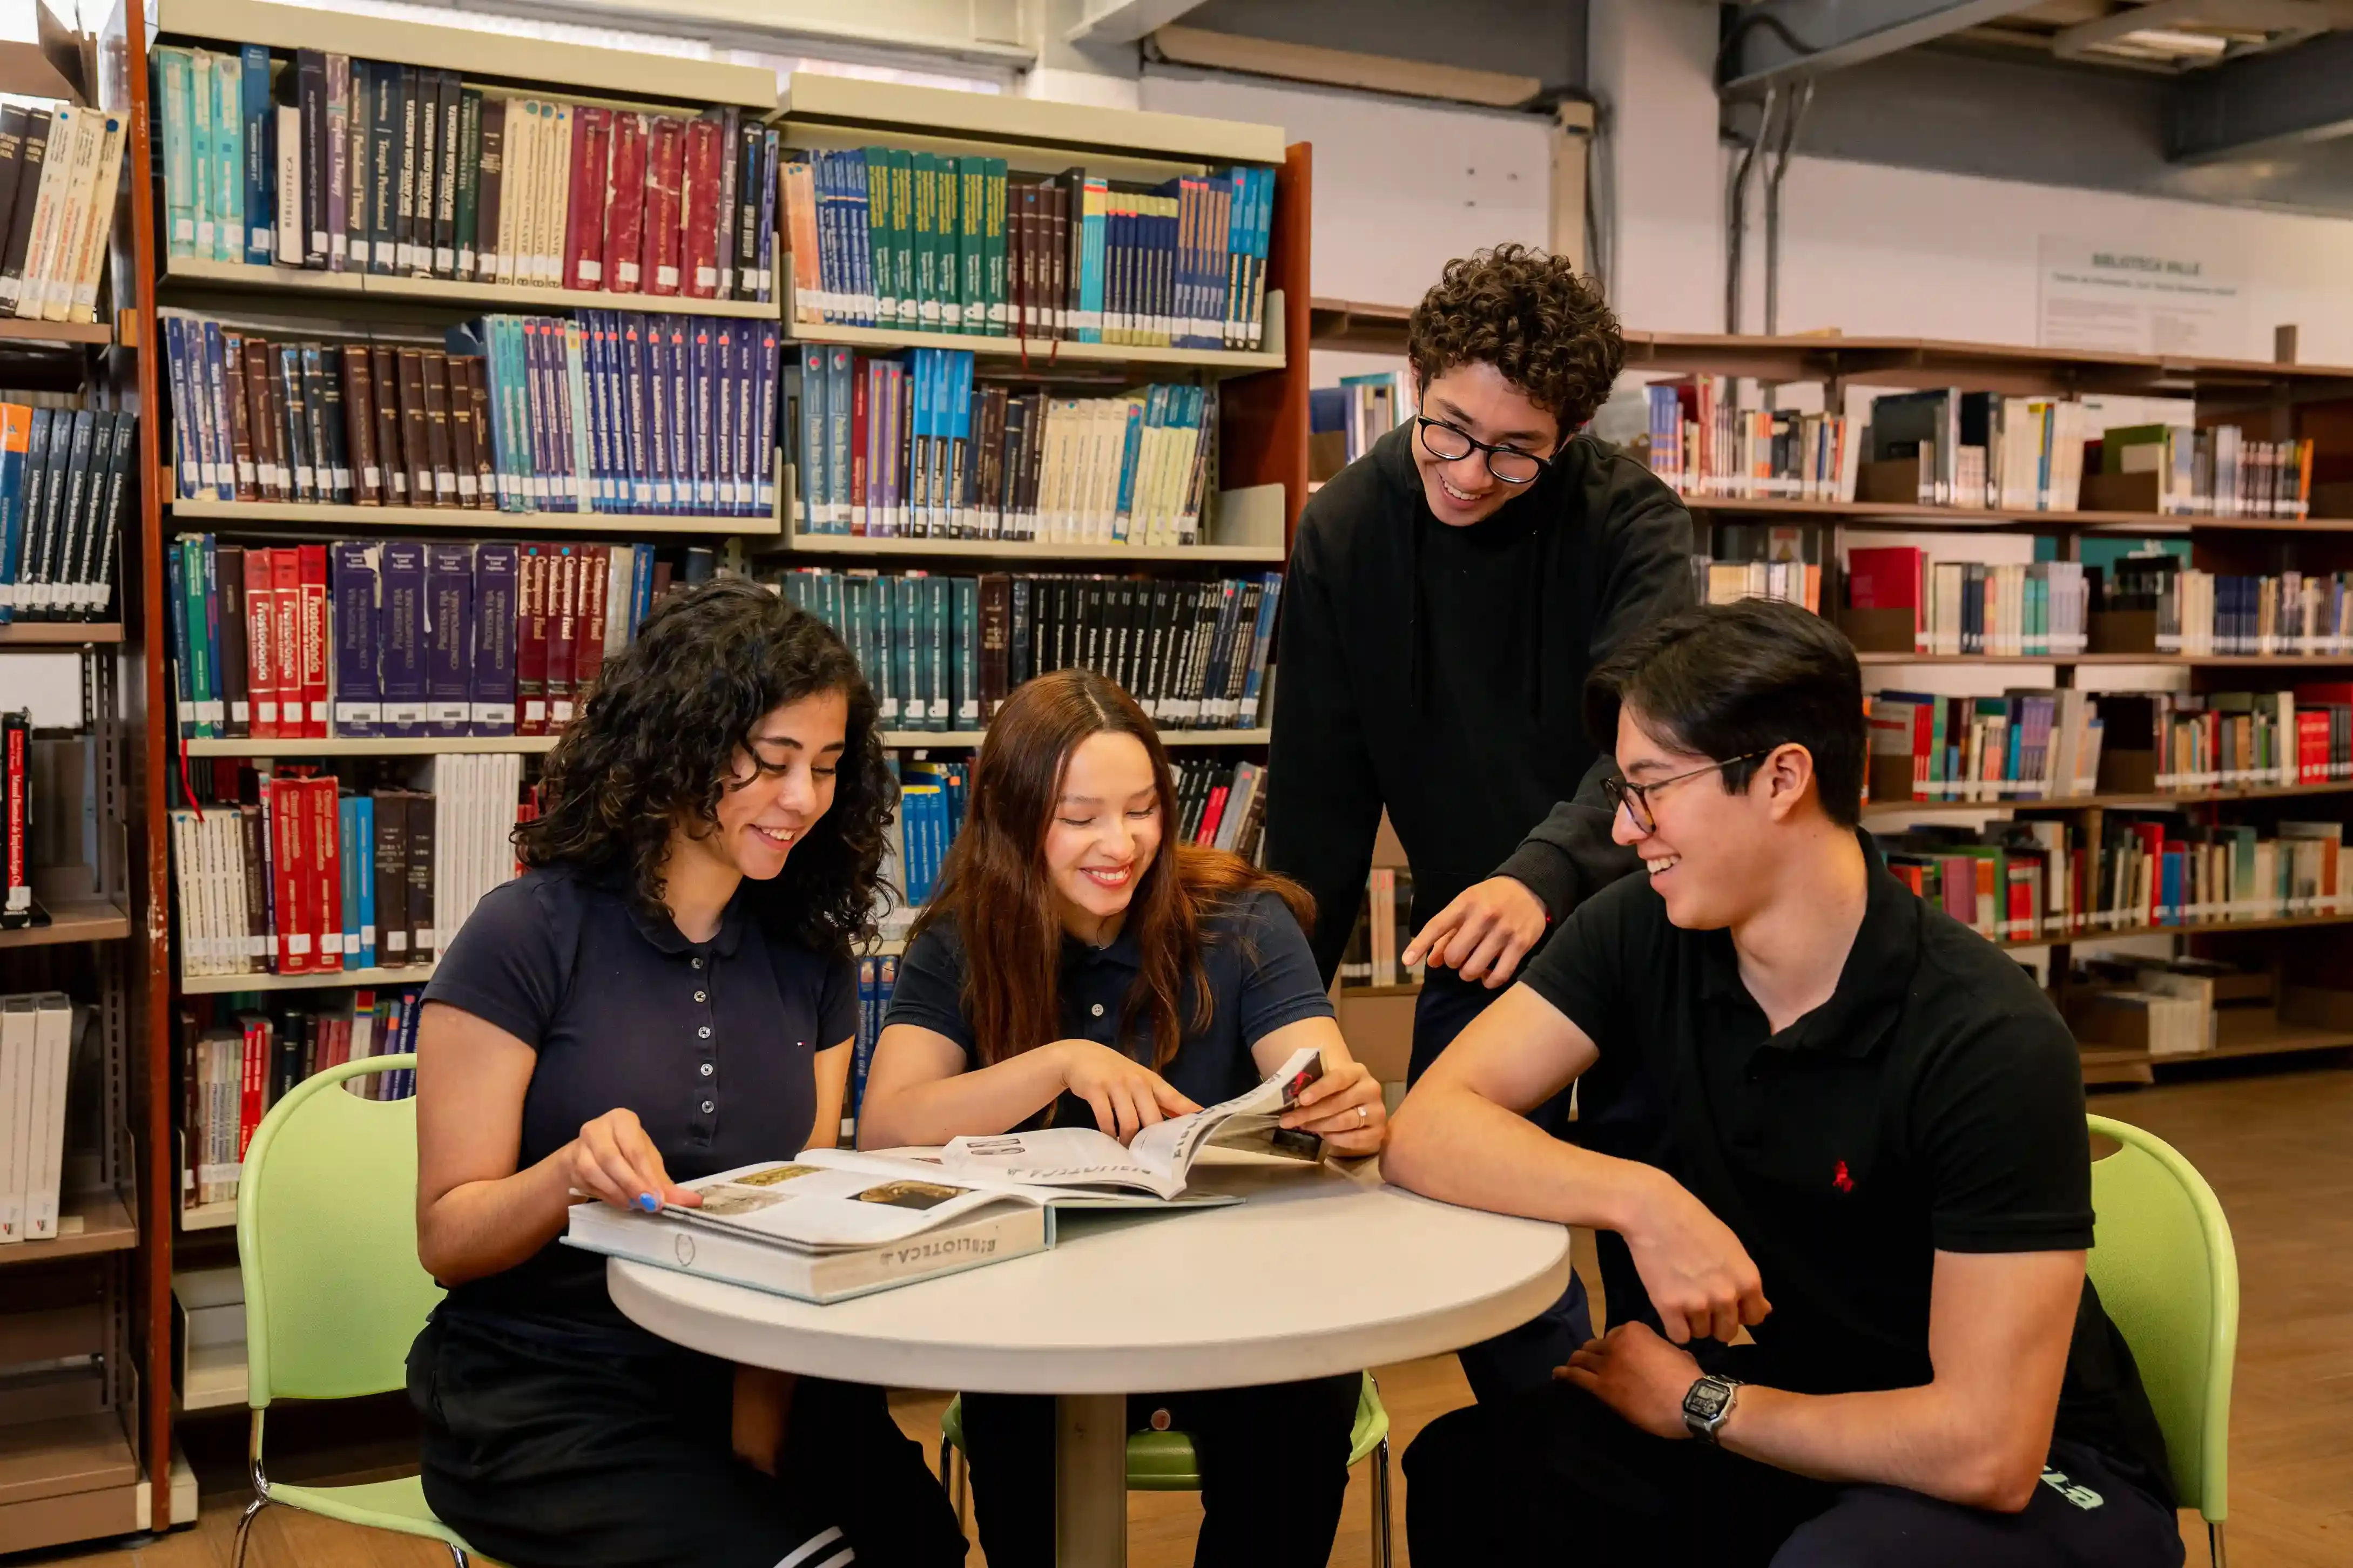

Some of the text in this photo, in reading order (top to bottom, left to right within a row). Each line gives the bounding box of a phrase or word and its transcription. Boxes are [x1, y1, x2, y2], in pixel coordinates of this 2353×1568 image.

[332, 158, 345, 197] Therapy
[309, 596, 322, 673] Prostodoncia
[532, 556, 547, 639] Contemporary Fixed
[562, 557, 576, 639] Contemporary Fixed
[590, 557, 606, 640] Contemporary Fixed
[858, 1059, 867, 1077] oral
[899, 1238, 996, 1264] BIBLIOTECA
